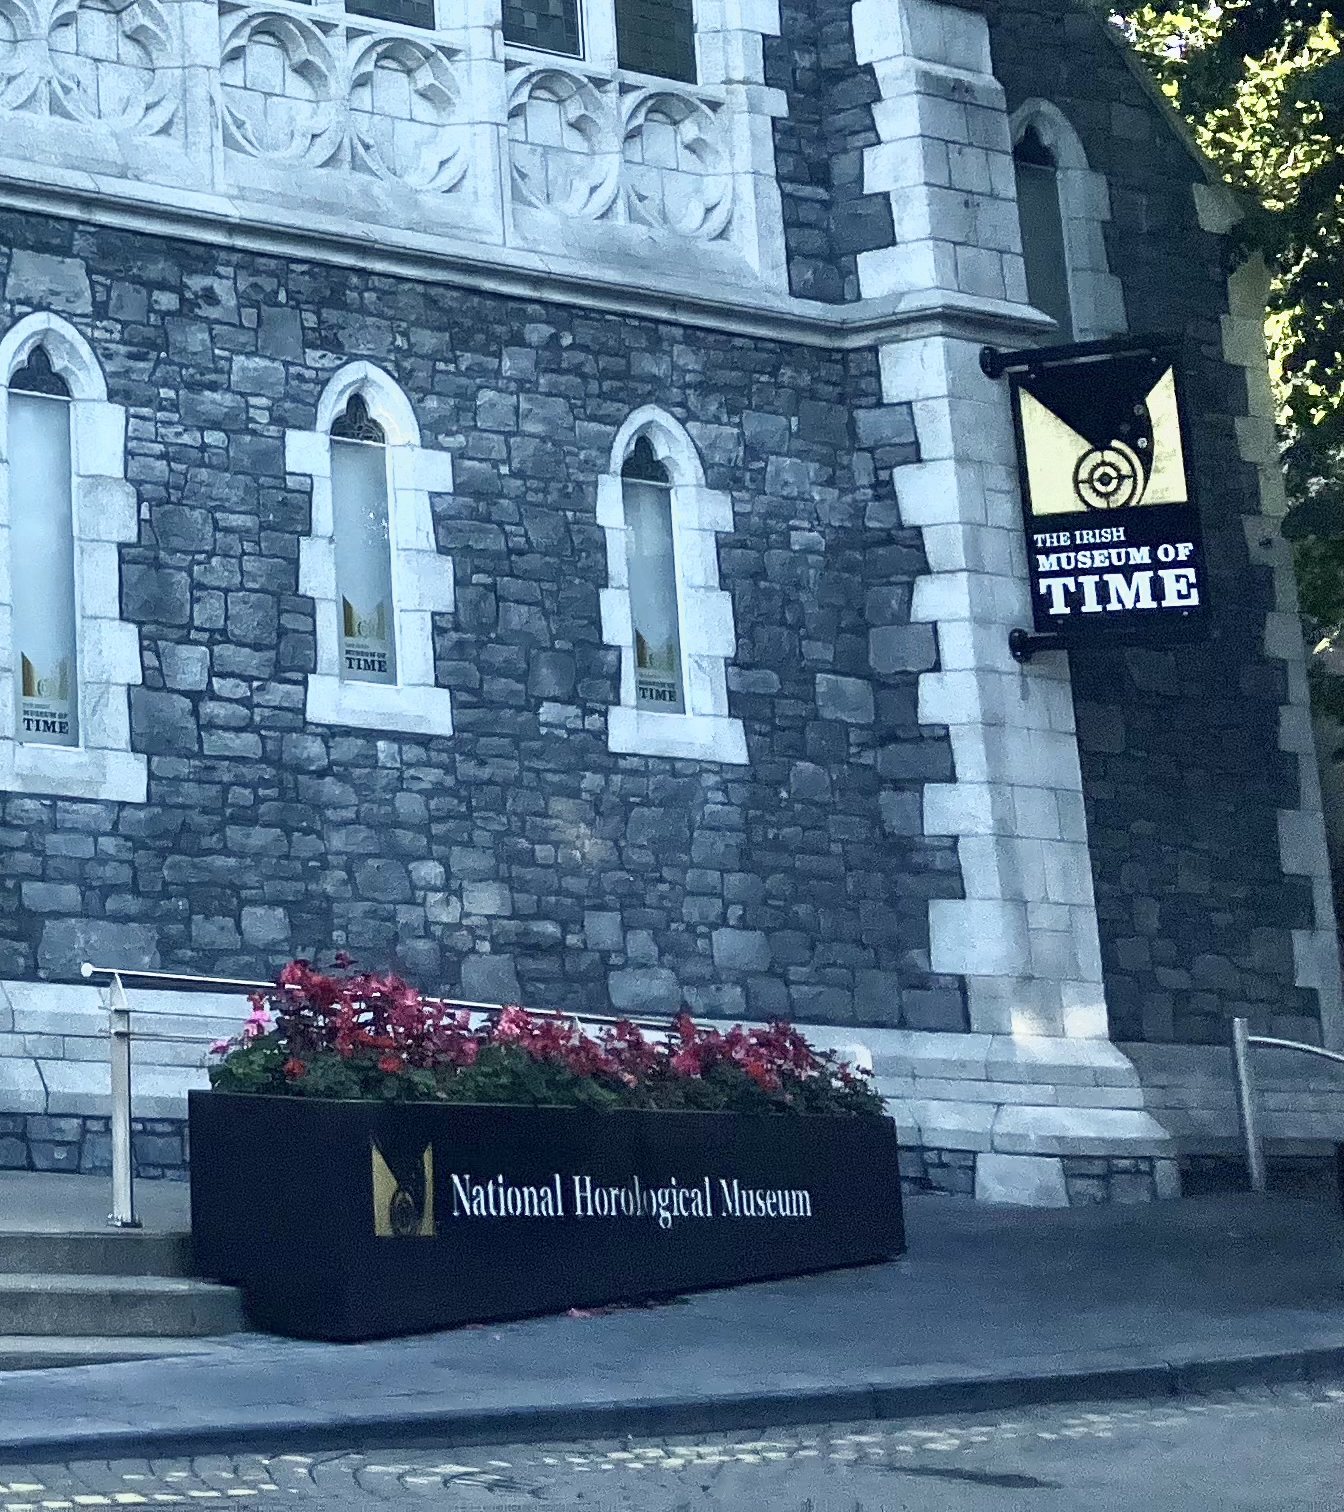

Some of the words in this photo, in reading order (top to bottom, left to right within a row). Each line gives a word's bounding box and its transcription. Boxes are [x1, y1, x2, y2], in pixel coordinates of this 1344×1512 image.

[1033, 531, 1071, 547] THE
[1074, 526, 1126, 544] IRISH
[1036, 545, 1152, 572] MUSEUM
[1156, 542, 1194, 562] OF
[1038, 567, 1200, 615] TIME
[344, 656, 388, 673] TIME
[638, 686, 677, 702] TIME
[22, 717, 69, 735] TIME
[450, 1173, 564, 1217] National
[572, 1175, 714, 1229] Horological
[719, 1178, 813, 1218] Museum
